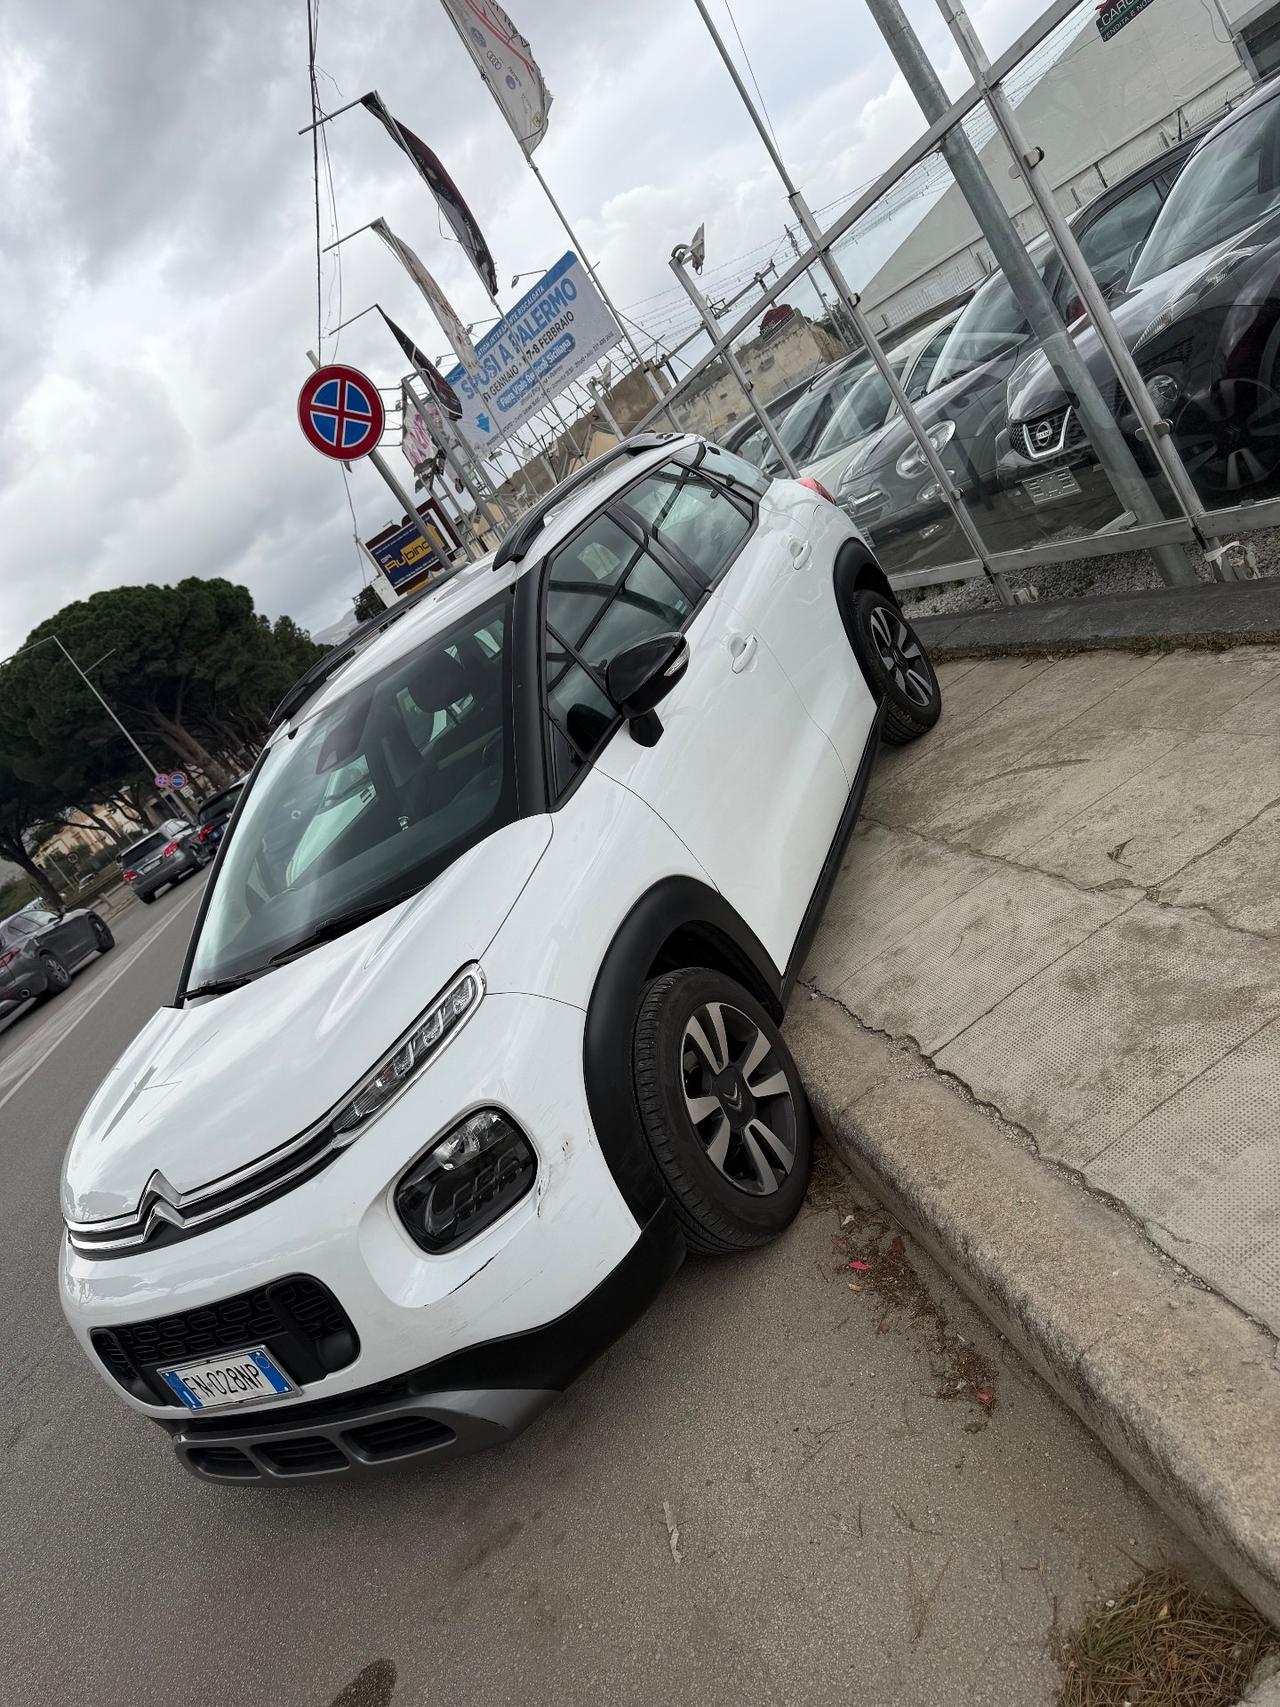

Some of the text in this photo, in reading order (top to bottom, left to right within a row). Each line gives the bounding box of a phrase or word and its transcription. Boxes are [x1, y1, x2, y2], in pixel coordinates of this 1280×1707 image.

[1103, 17, 1130, 41] VENDITA
[461, 354, 502, 400] SPOSI
[498, 343, 515, 367] A
[507, 278, 577, 354] PALERMO
[489, 364, 519, 396] GENNAIO
[539, 310, 575, 350] FEBBRAIO
[546, 338, 572, 364] Siciliana
